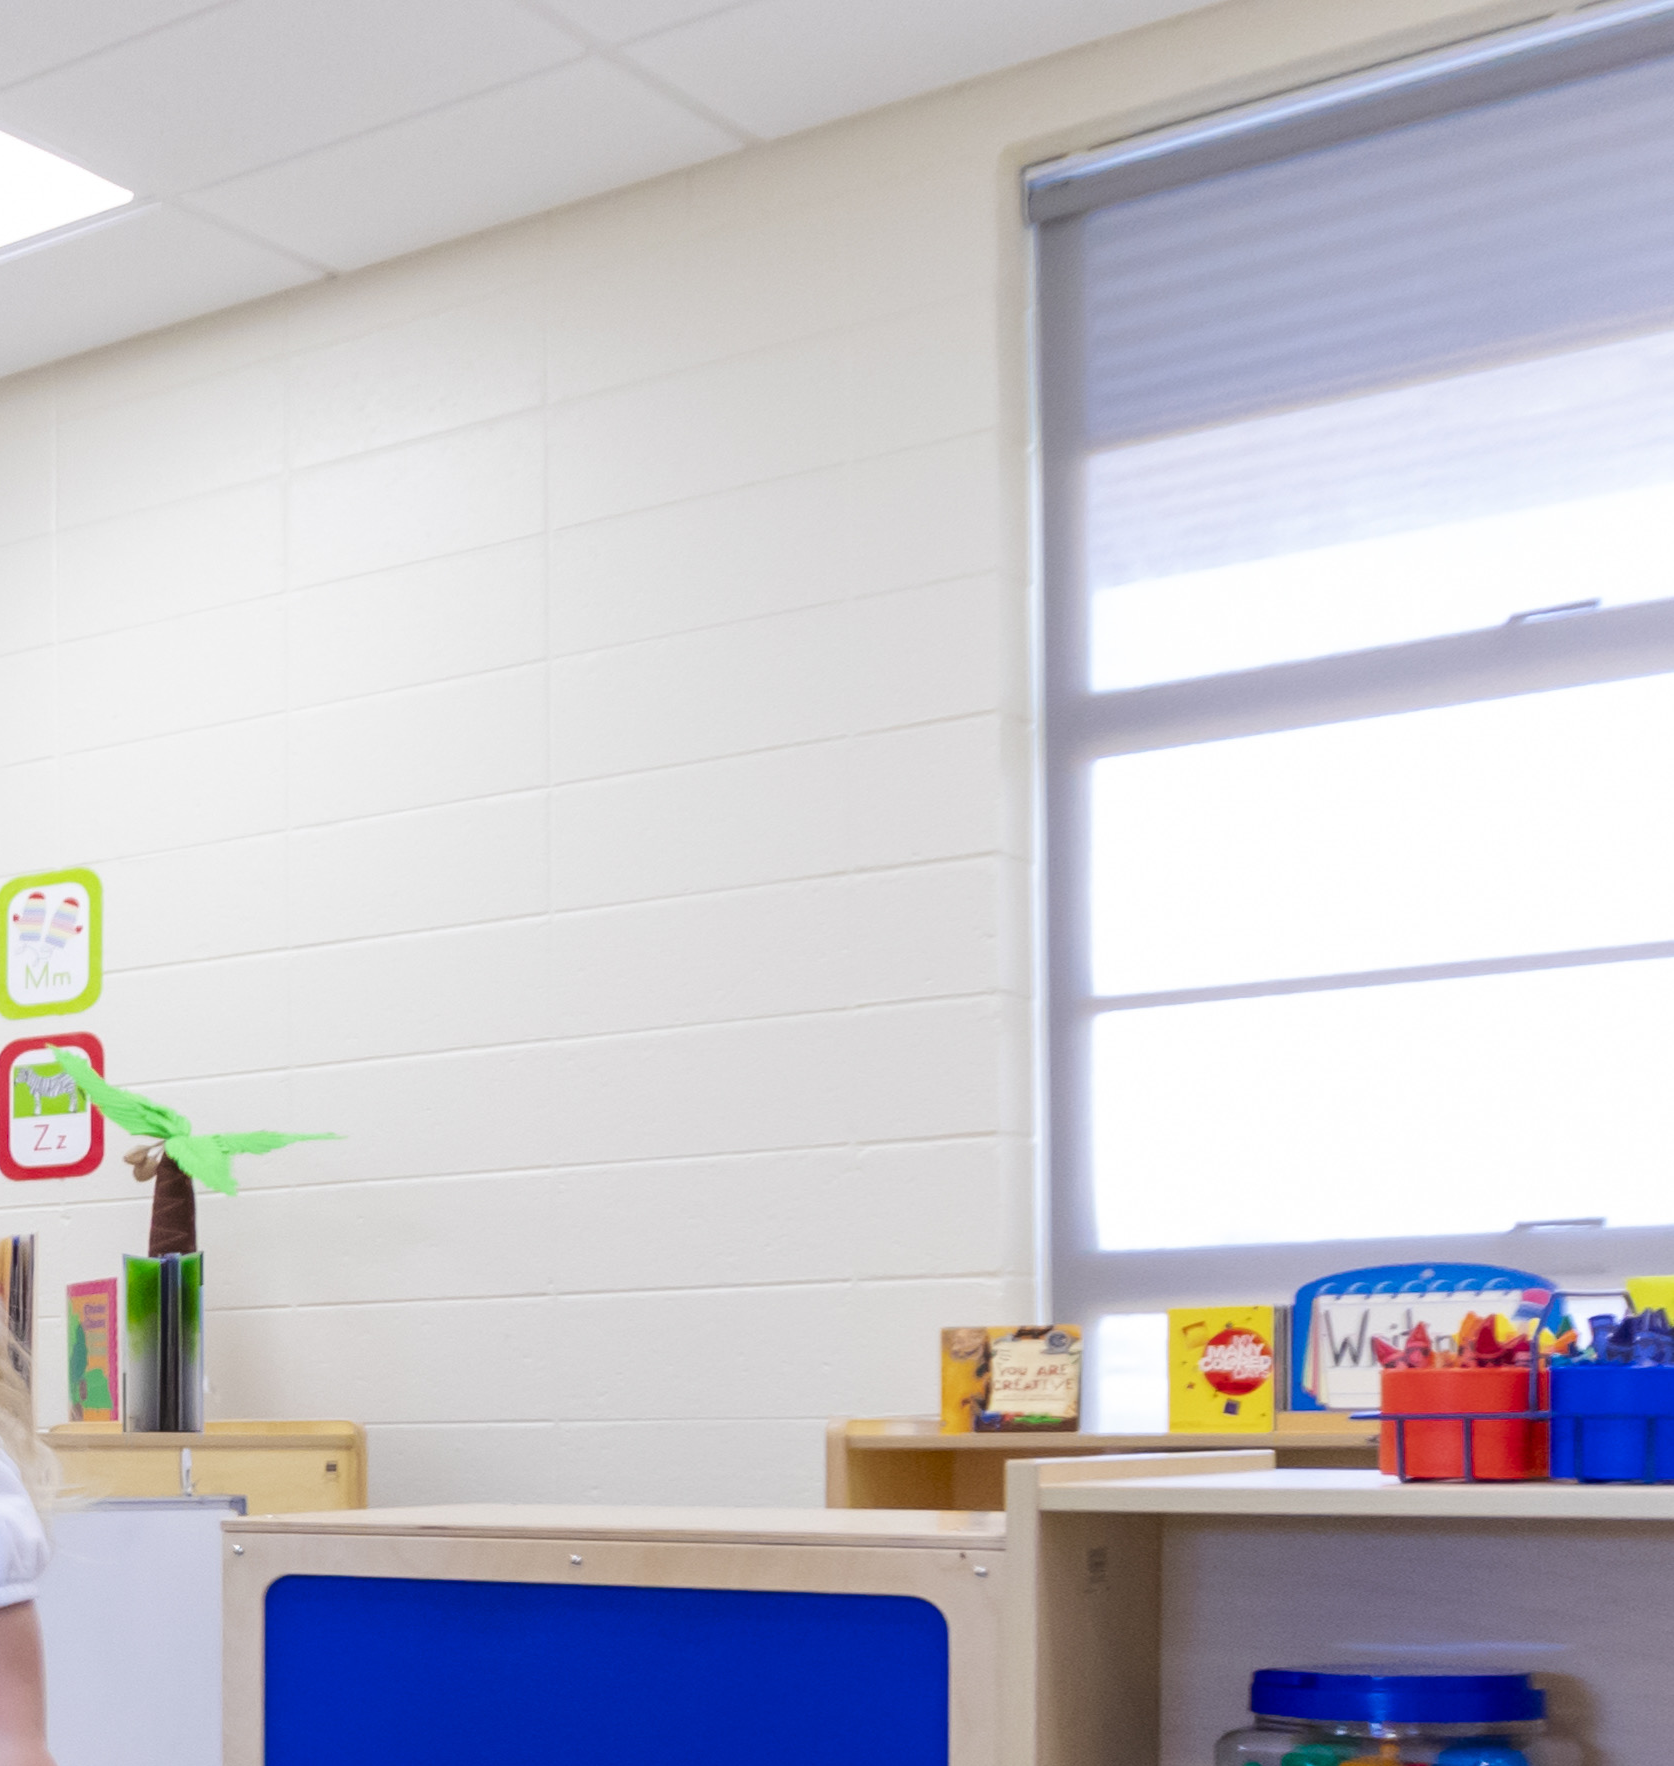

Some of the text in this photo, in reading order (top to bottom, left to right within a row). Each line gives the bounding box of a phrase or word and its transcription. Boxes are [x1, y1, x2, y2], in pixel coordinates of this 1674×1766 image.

[25, 962, 72, 990] Mm
[33, 1124, 68, 1152] Zz
[1208, 1344, 1264, 1359] MANY
[1000, 1364, 1069, 1377] YOU ARE
[1198, 1356, 1272, 1372] COLORED
[994, 1379, 1075, 1391] CREATIVE
